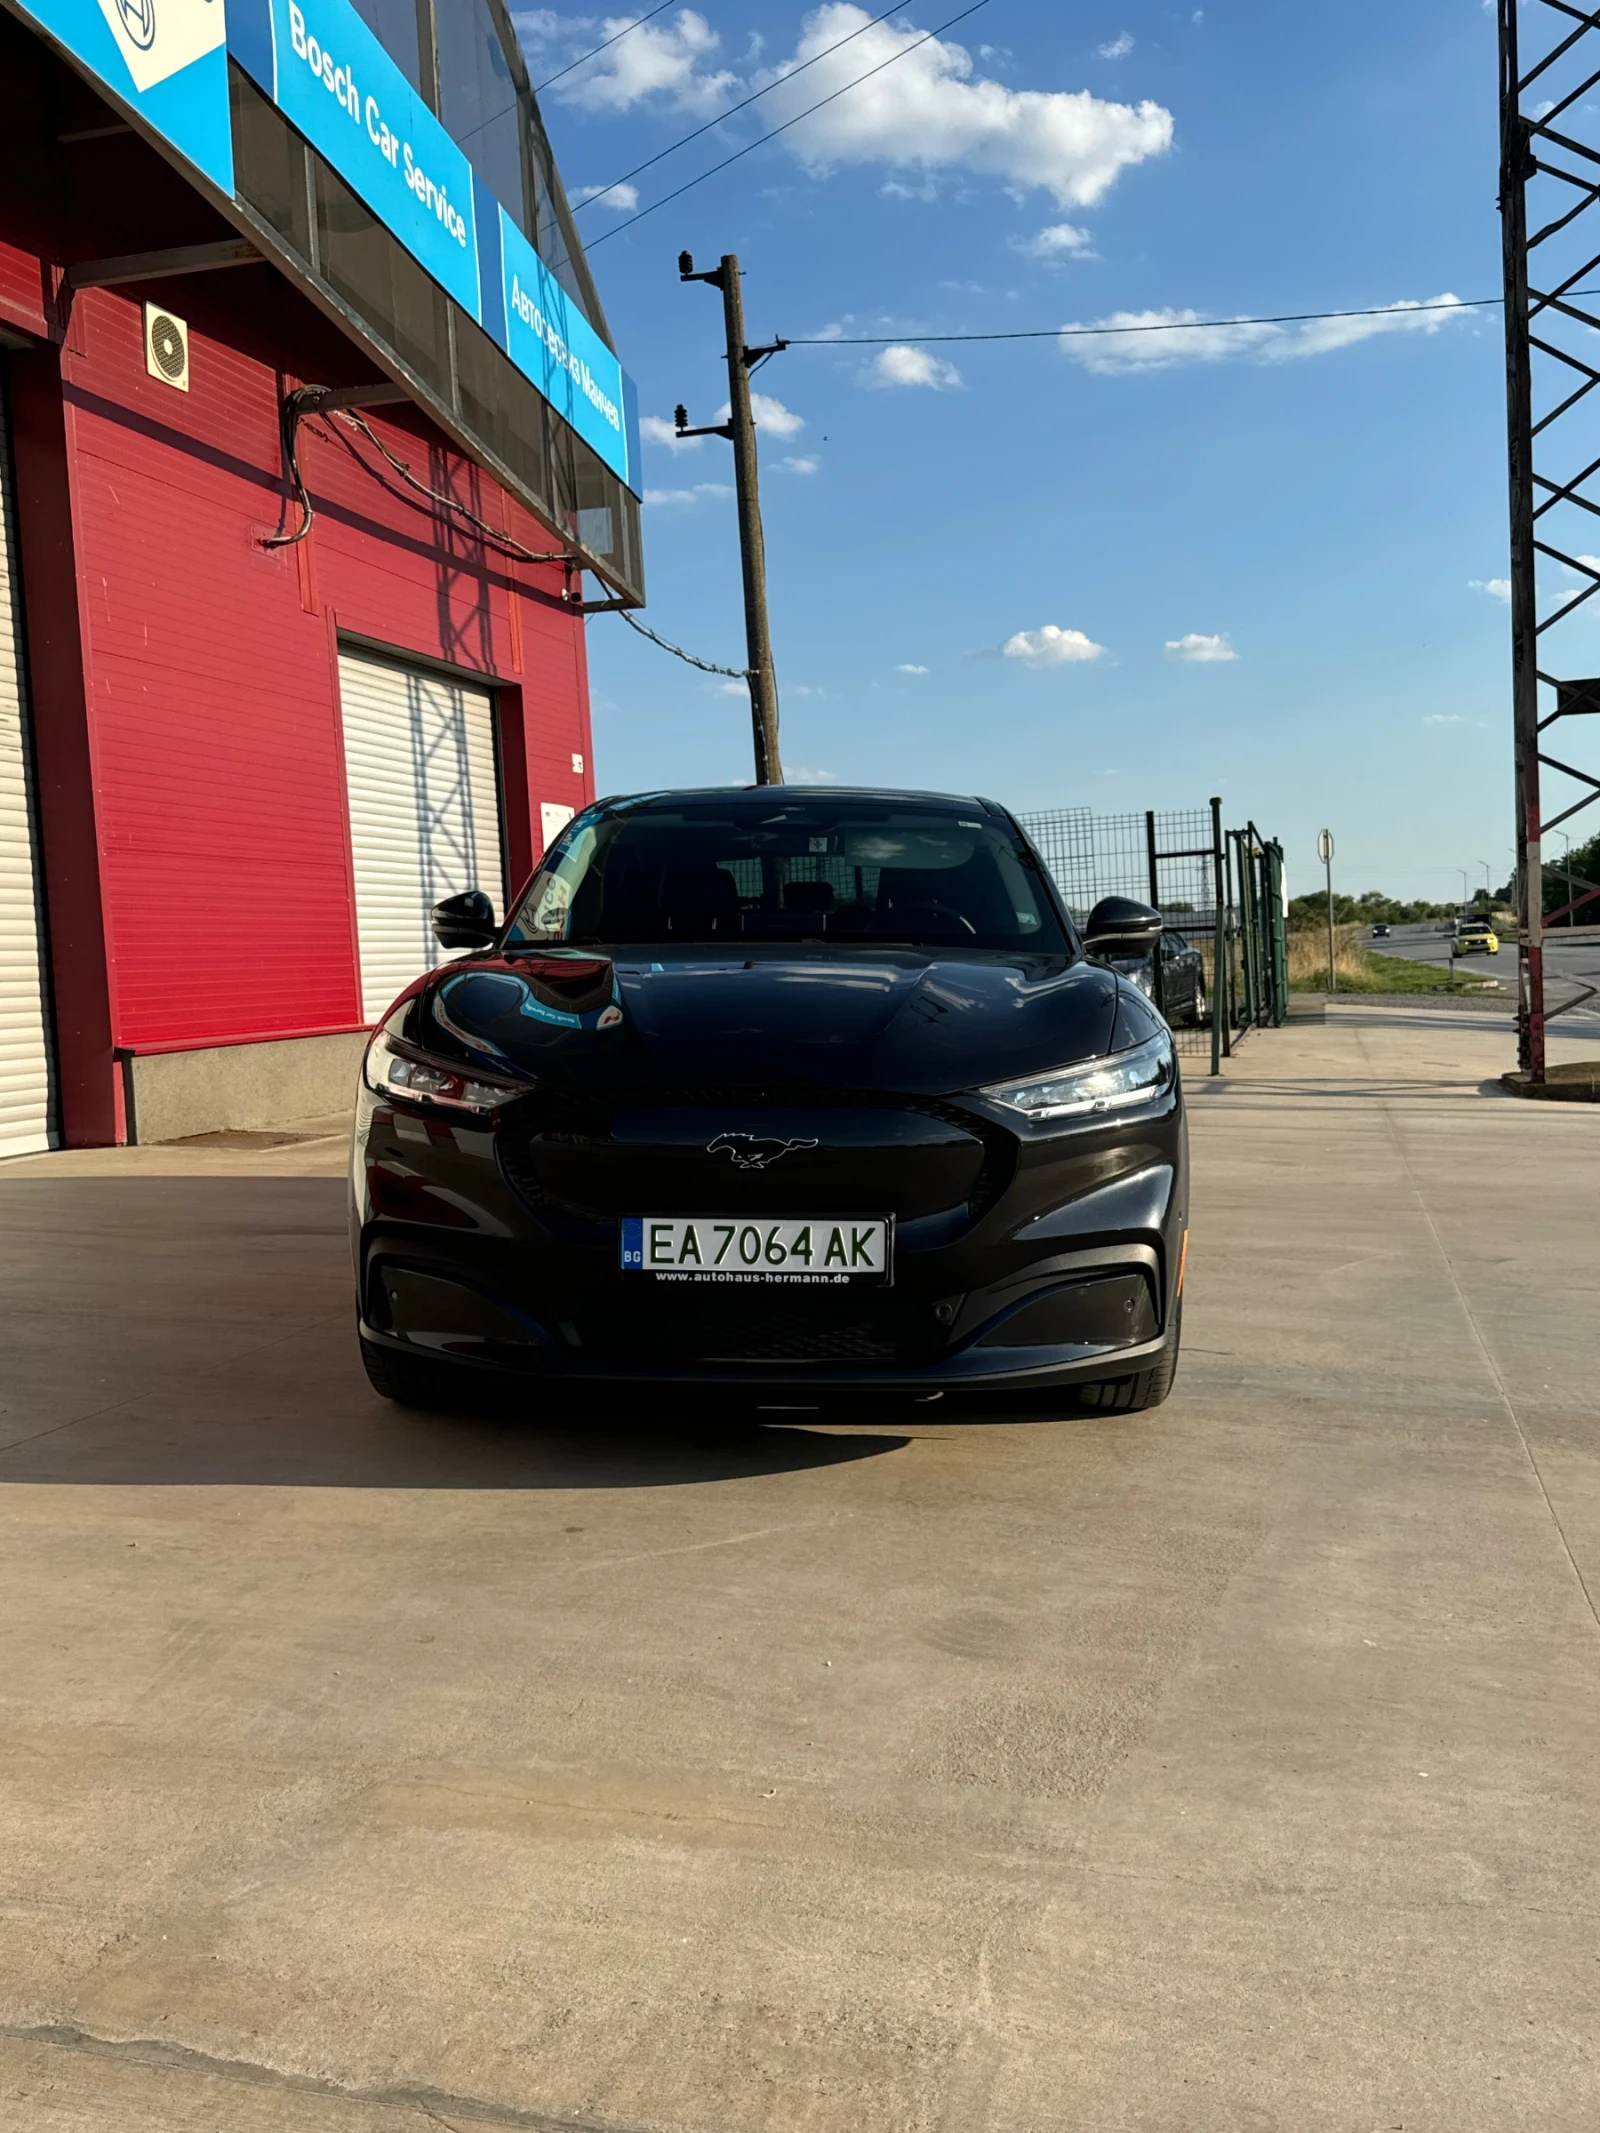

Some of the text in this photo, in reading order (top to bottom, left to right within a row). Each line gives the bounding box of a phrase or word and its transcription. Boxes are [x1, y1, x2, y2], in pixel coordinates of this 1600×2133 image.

[288, 0, 467, 248] Bosch Car Service
[511, 274, 621, 432] Автосервиз Манчев
[624, 1224, 877, 1268] BG EA 7064 AK
[655, 1272, 850, 1285] www.autohaus-hermann.de
